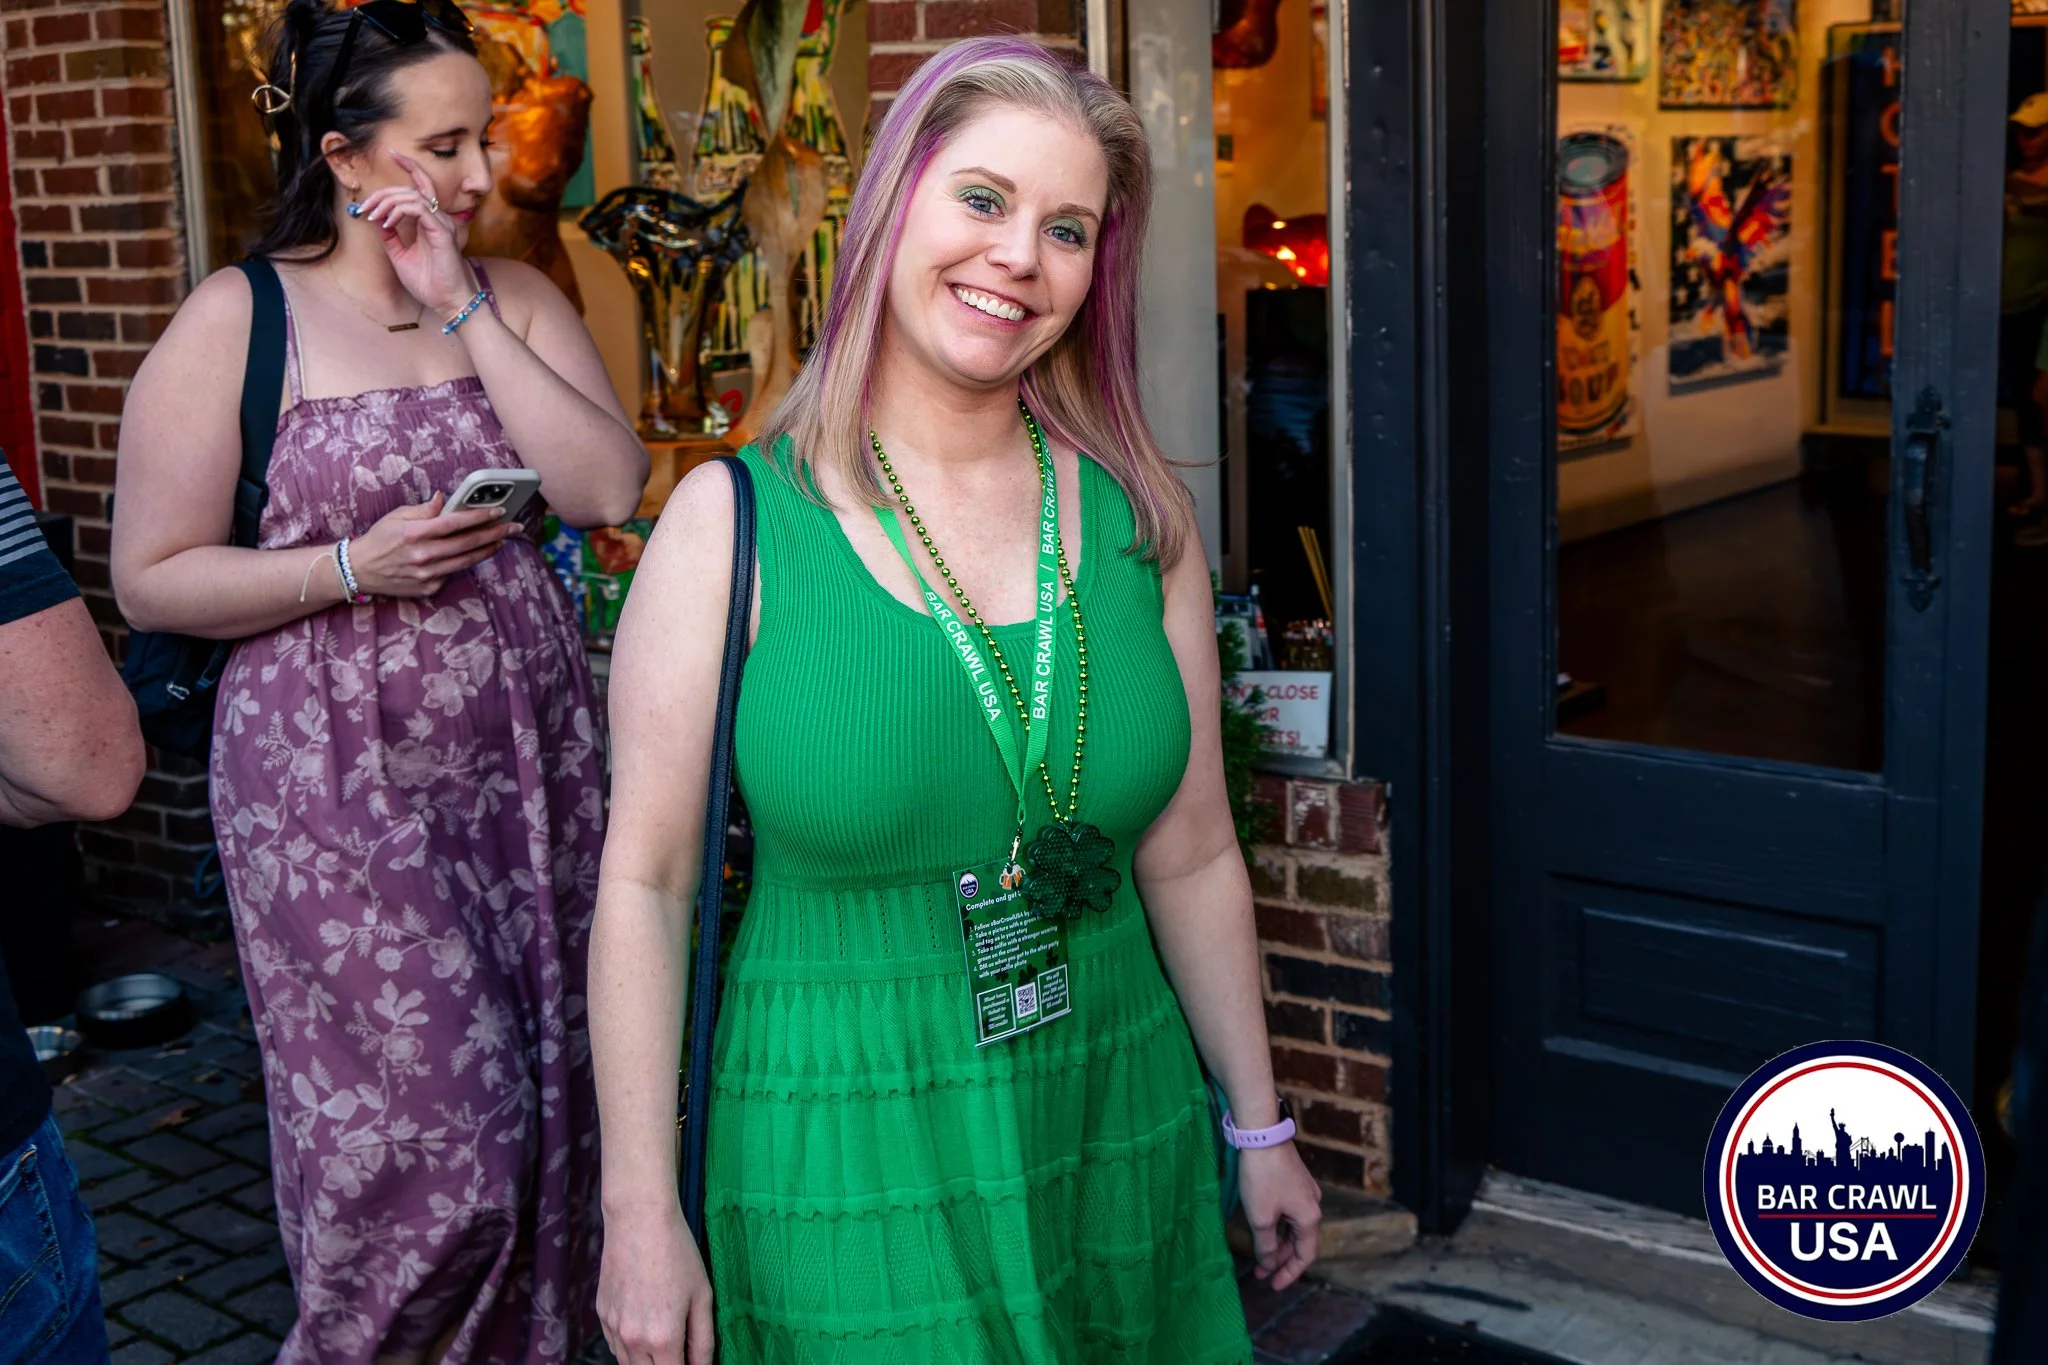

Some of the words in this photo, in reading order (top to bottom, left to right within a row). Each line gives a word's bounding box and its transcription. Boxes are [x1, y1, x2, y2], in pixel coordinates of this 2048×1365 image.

[1045, 469, 1056, 518] CRAWL
[1042, 523, 1054, 555] BAR
[1040, 582, 1053, 612] USA
[925, 592, 952, 620] BAR
[947, 621, 984, 681] CRAWL
[979, 682, 1001, 721] USA
[1036, 616, 1053, 675] CRAWL
[1033, 681, 1048, 719] BAR
[1266, 684, 1319, 700] CLOSE
[965, 899, 995, 911] Complete
[995, 893, 1007, 903] and
[1007, 892, 1017, 901] get
[974, 923, 990, 931] Follow
[992, 926, 1008, 936] picture
